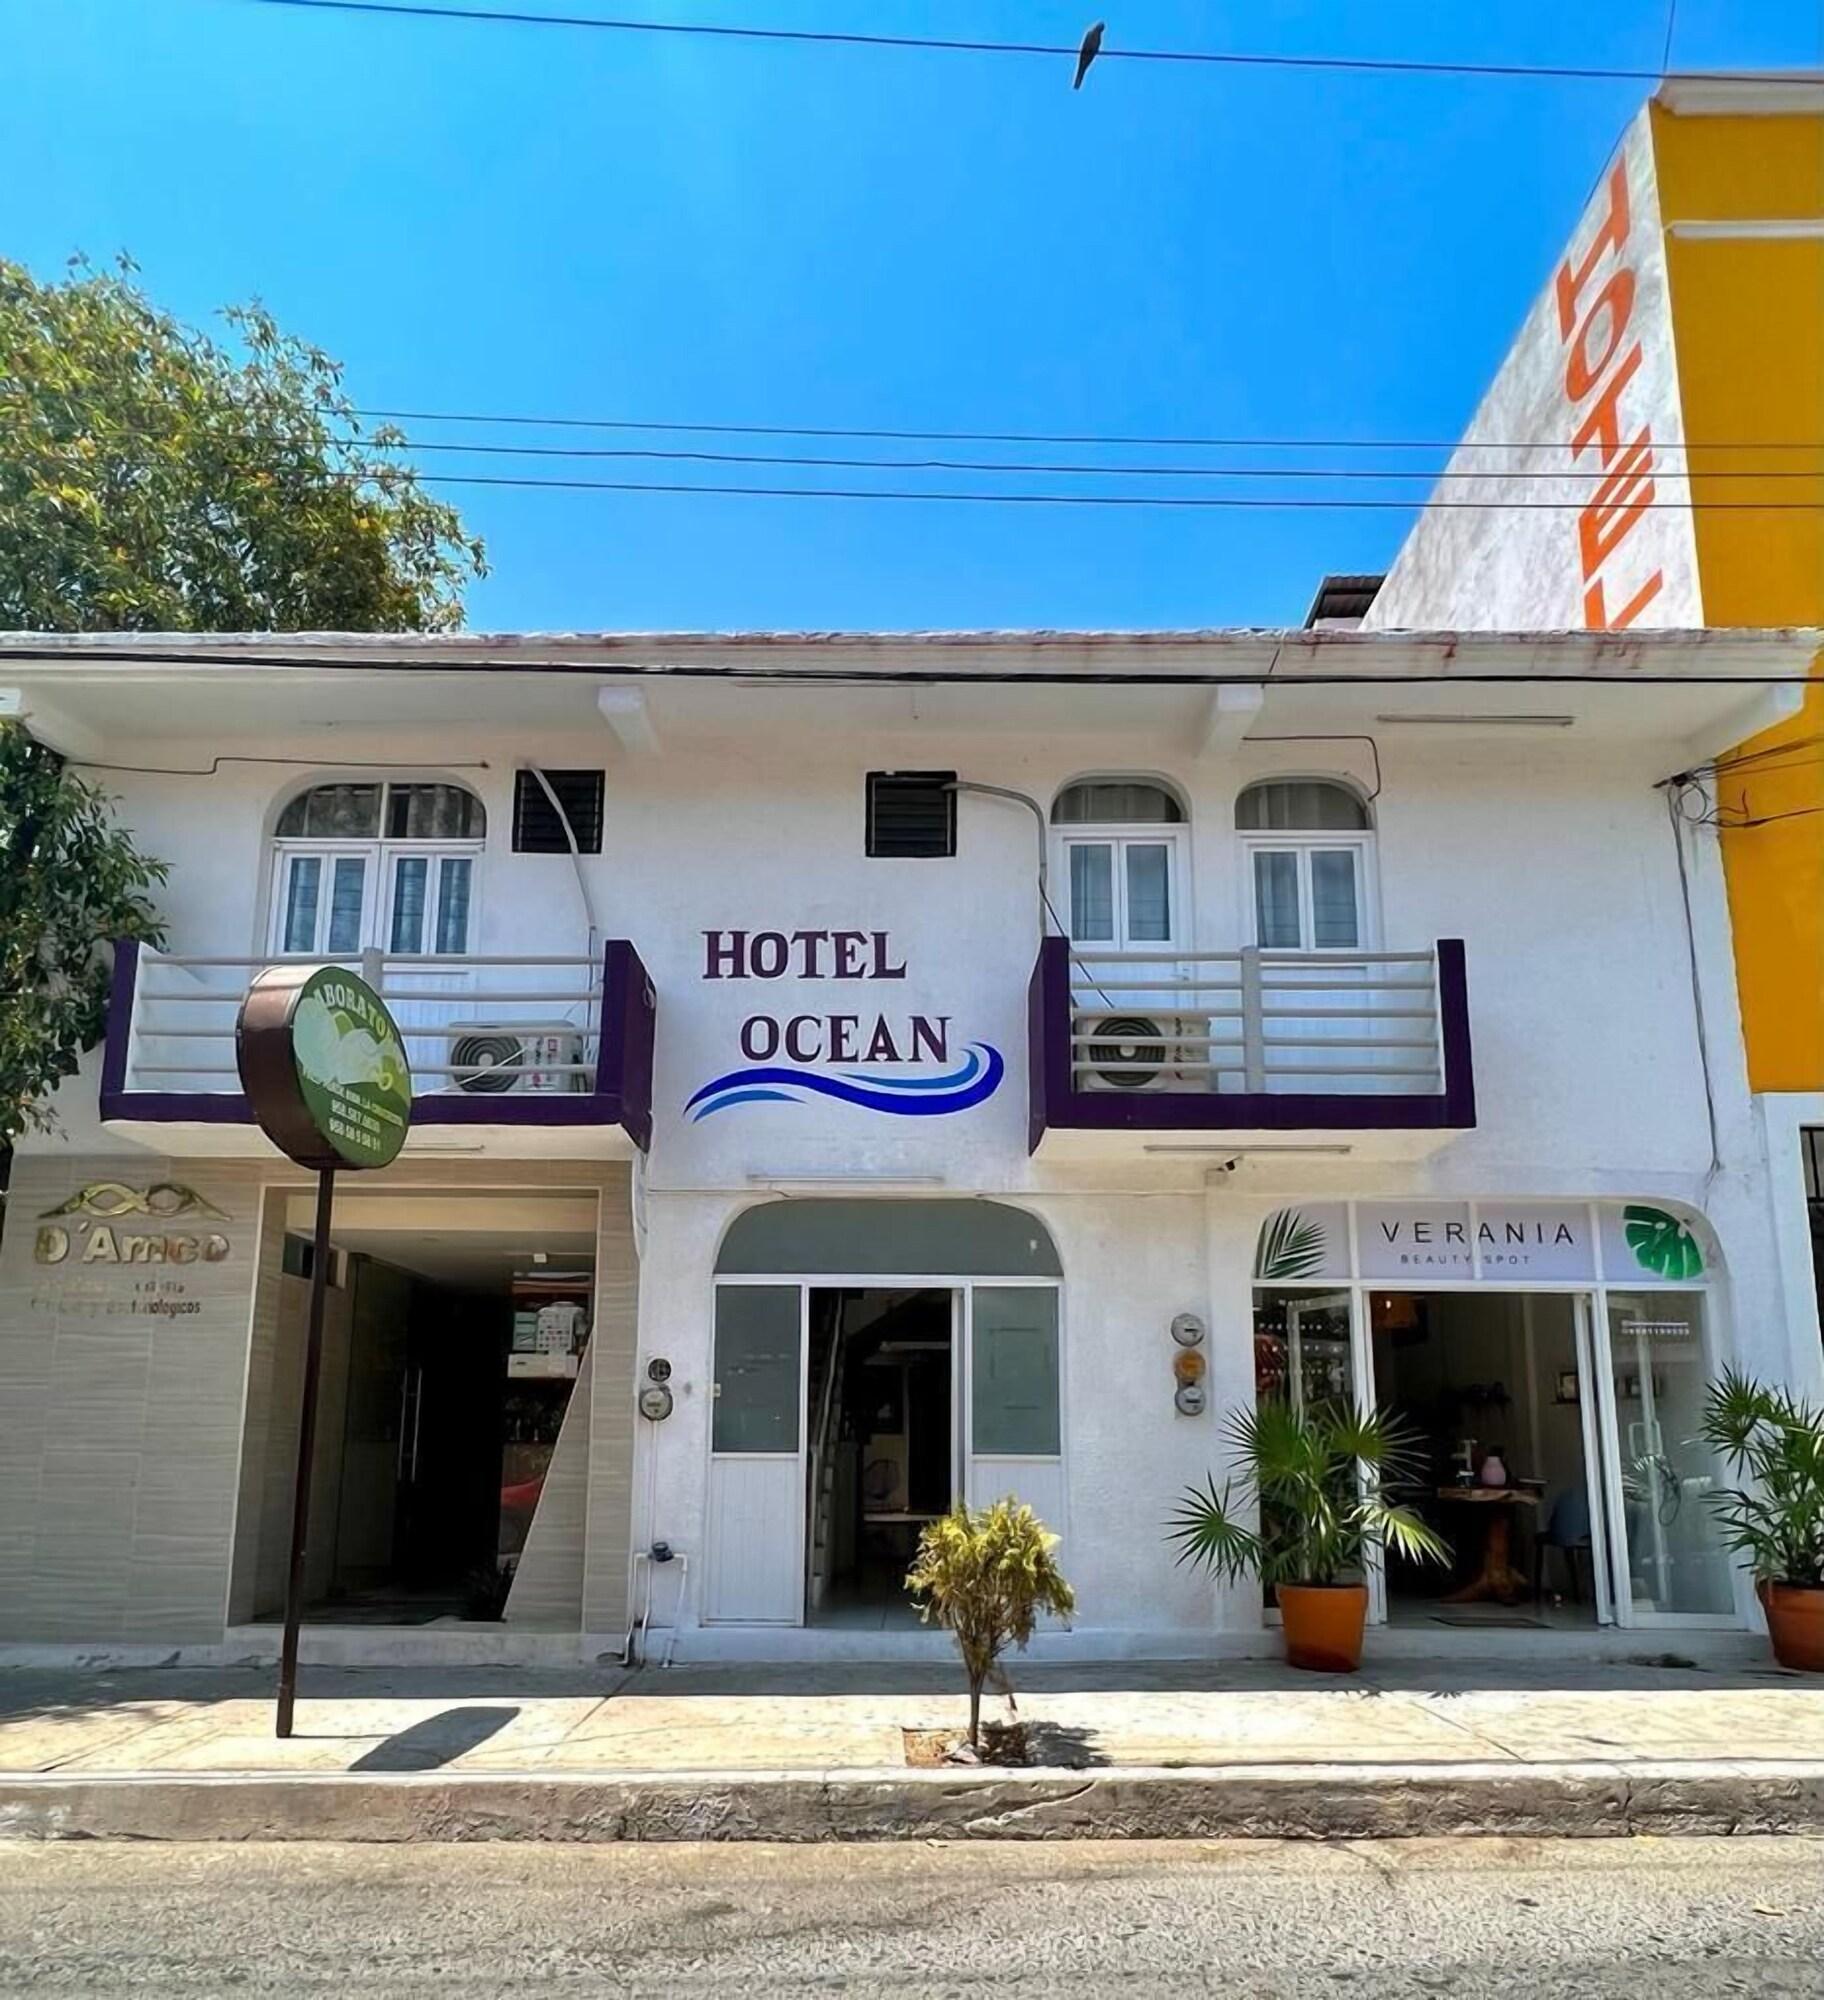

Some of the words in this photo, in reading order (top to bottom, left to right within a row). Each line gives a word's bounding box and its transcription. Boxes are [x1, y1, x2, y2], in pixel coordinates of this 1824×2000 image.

[1556, 149, 1664, 630] HOTEL
[701, 930, 908, 980] HOTEL
[739, 1013, 953, 1064] OCEAN
[1381, 1221, 1574, 1245] VERANIA
[1400, 1253, 1474, 1266] BEAUTY
[1483, 1253, 1532, 1266] SPOT
